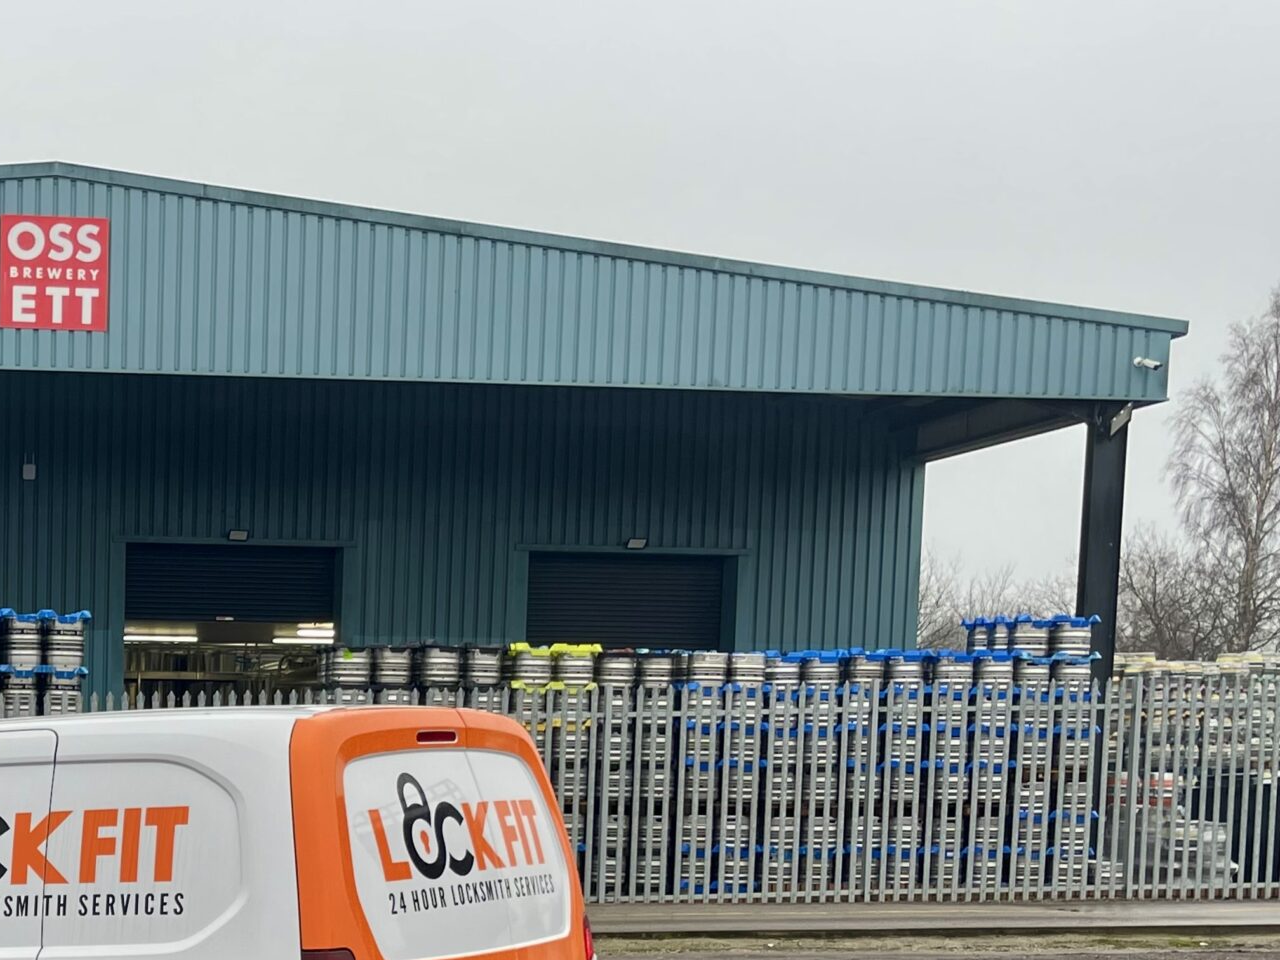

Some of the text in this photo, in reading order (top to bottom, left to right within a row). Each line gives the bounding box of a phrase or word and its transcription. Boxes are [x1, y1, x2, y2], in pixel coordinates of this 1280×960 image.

[7, 221, 102, 263] OSS
[9, 266, 100, 281] BREWERY
[11, 285, 100, 325] ETT
[78, 893, 185, 916] SERVICES
[388, 874, 555, 915] 24 HOUR LOCKSMITH SERVICES
